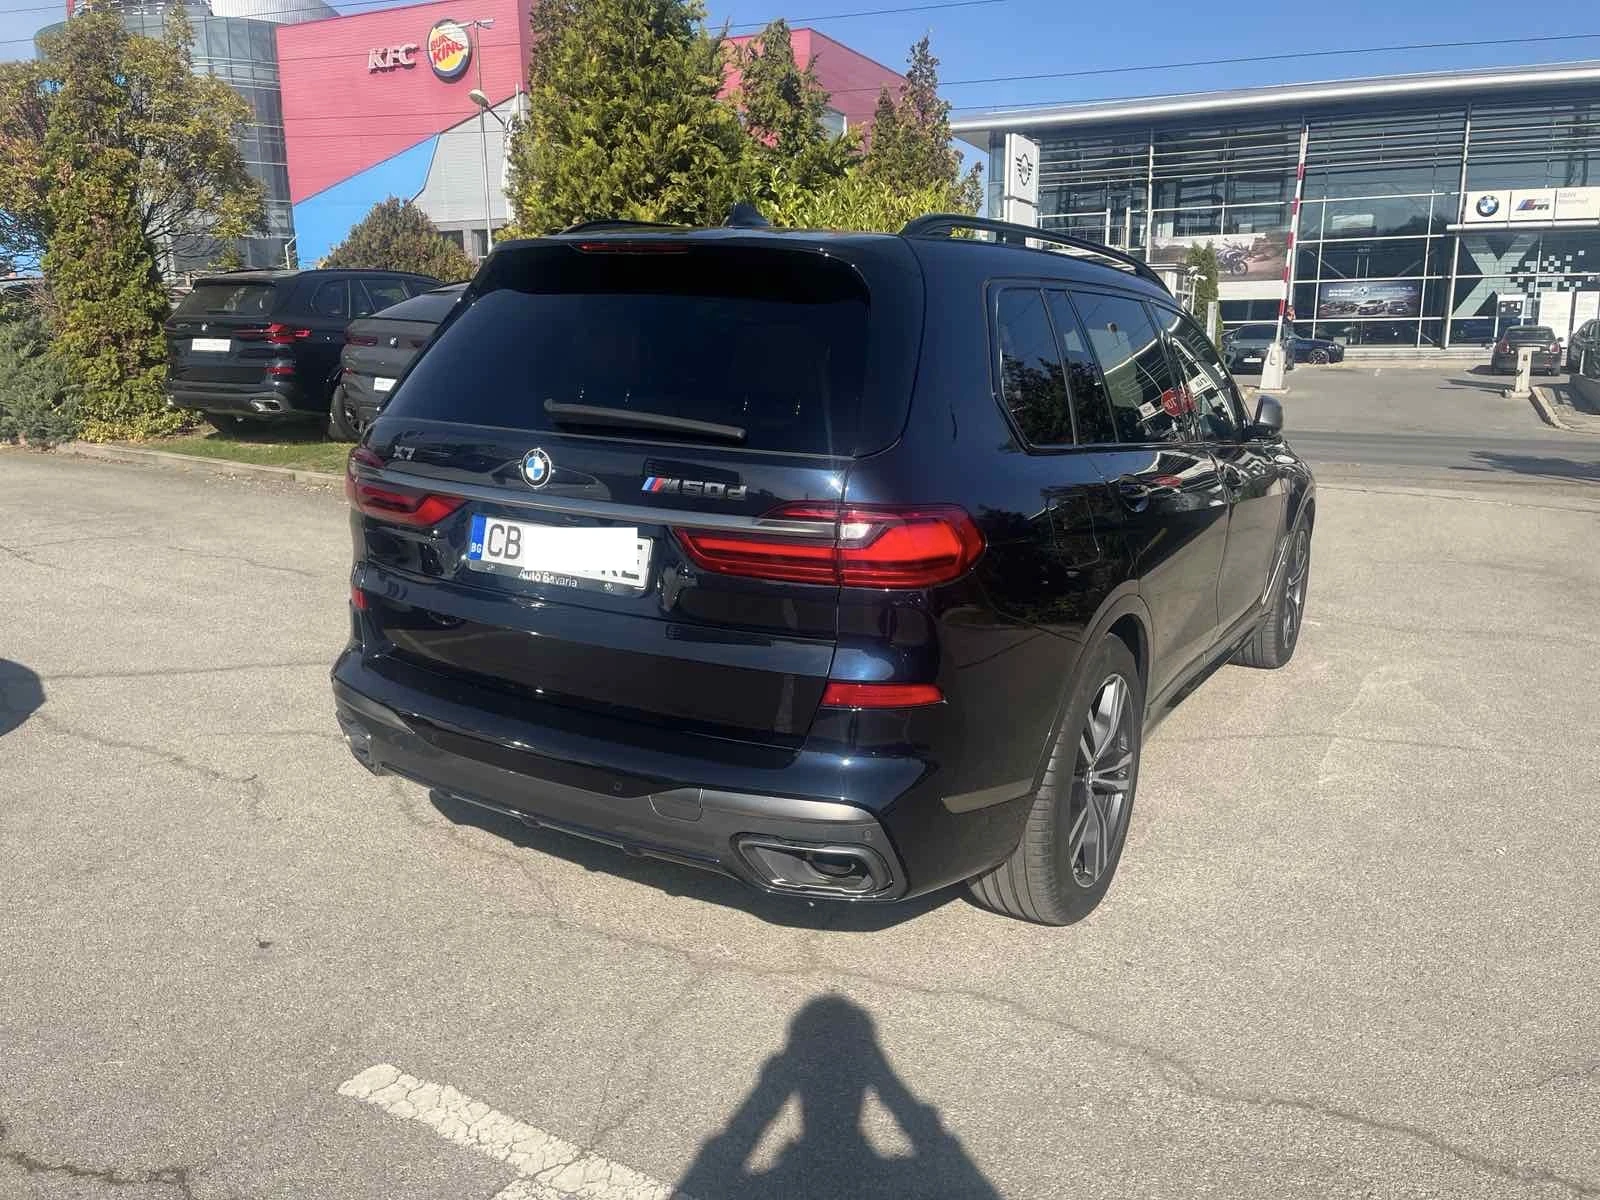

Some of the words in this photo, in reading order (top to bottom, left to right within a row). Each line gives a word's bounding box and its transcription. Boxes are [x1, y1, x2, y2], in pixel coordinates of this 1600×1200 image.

[368, 44, 418, 72] KFC
[393, 445, 415, 460] X7
[471, 542, 482, 553] BG
[487, 523, 521, 560] CB
[518, 568, 541, 582] Auto
[543, 571, 577, 588] Bavaria
